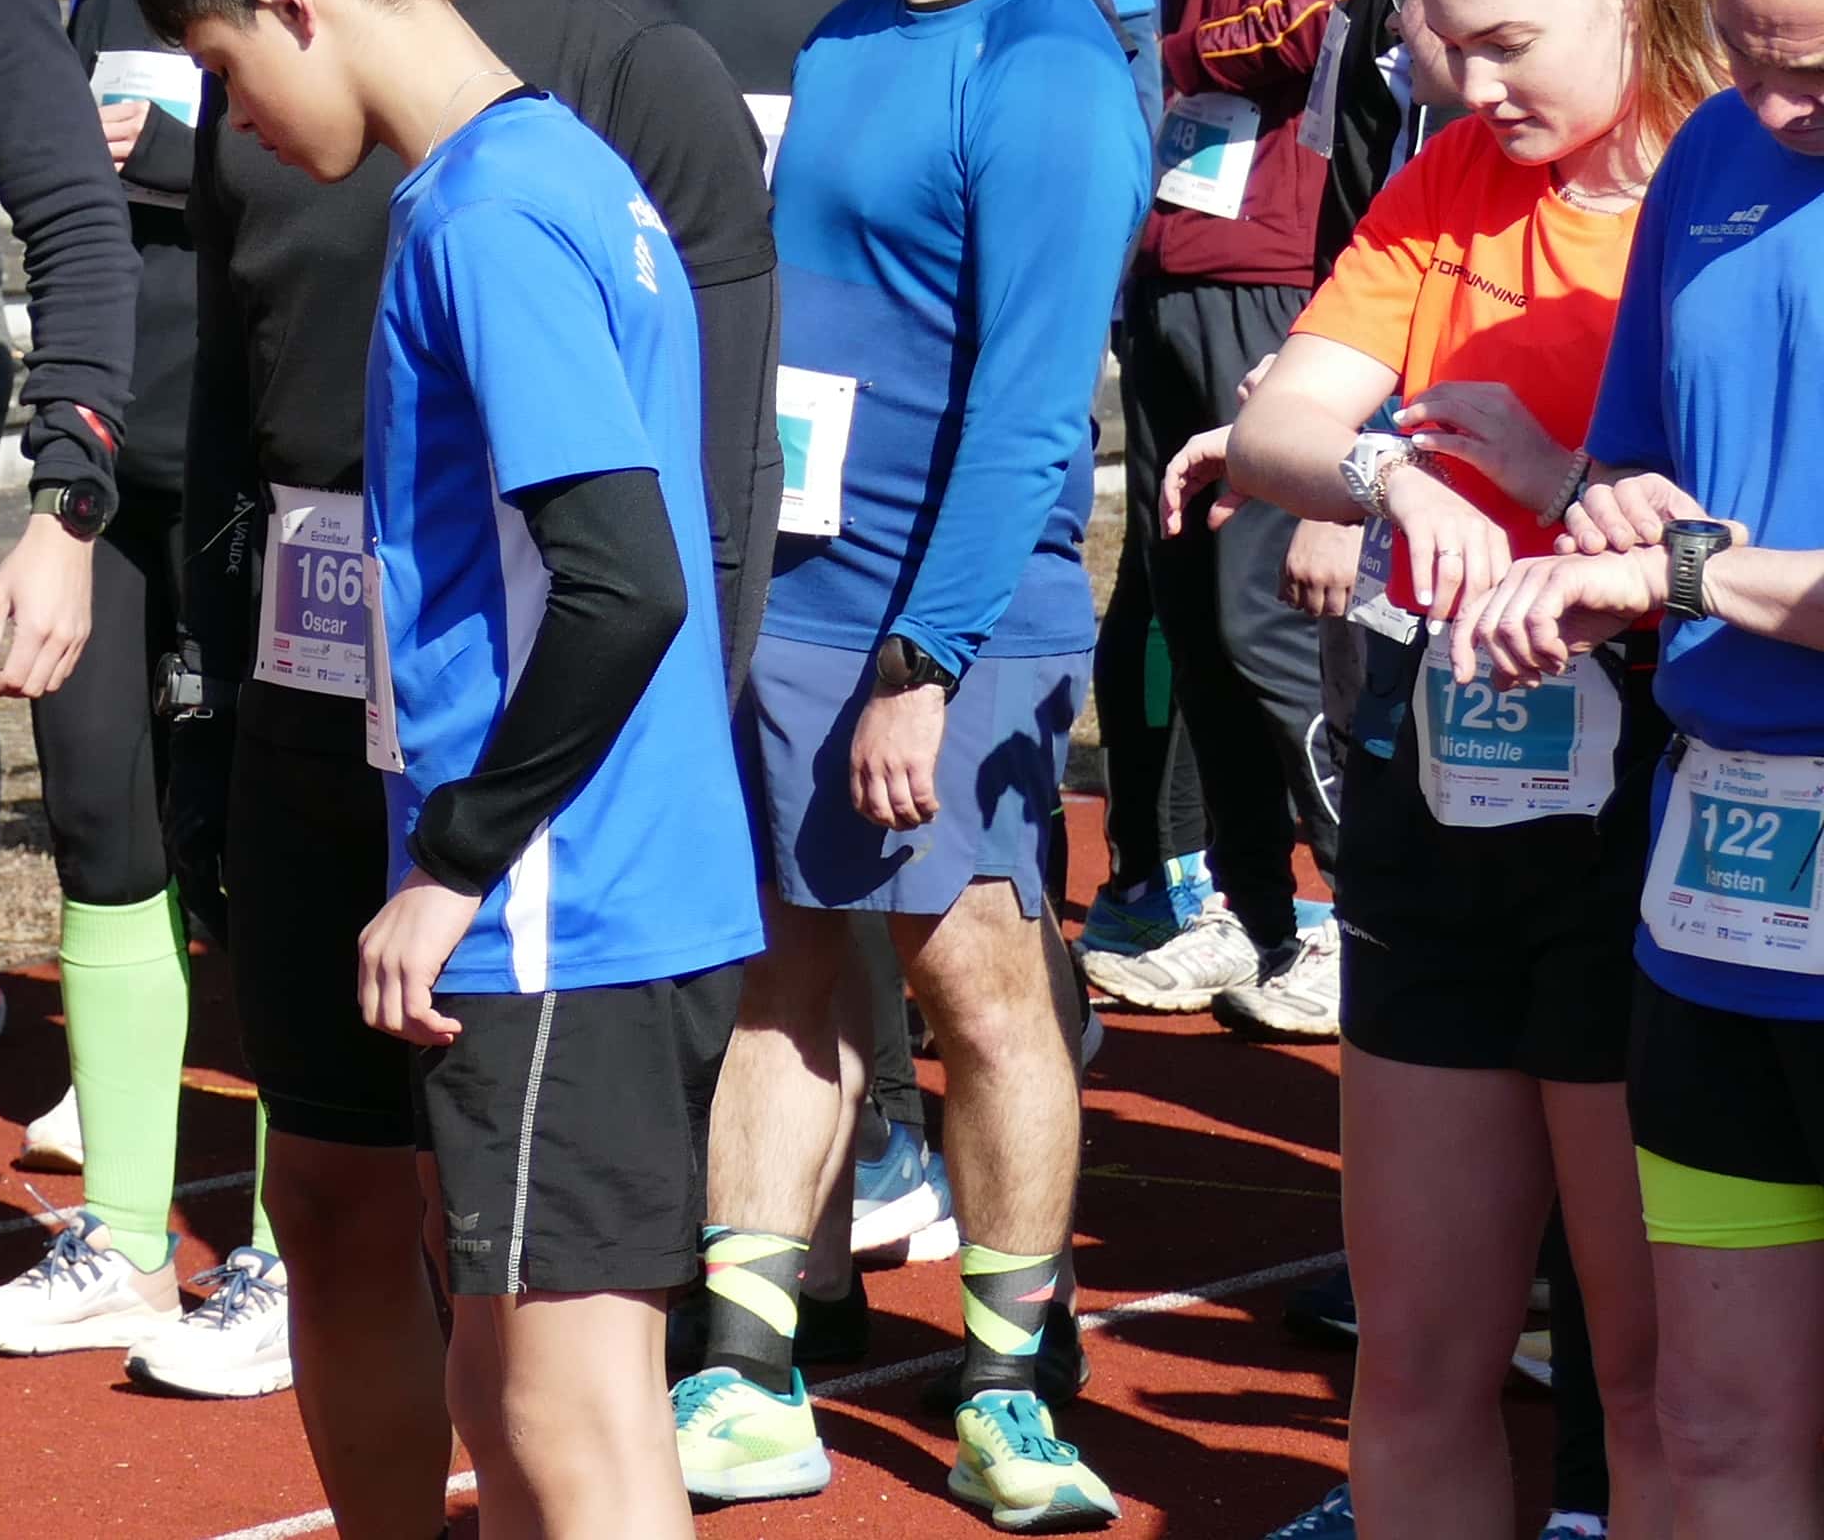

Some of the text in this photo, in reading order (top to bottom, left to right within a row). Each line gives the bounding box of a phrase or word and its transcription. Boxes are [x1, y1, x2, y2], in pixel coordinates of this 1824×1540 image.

[1172, 120, 1198, 151] 48
[226, 521, 249, 575] VAUDE
[298, 552, 363, 606] 166
[302, 610, 347, 636] Oscar
[1443, 678, 1528, 732] 125
[1701, 804, 1781, 861] 122
